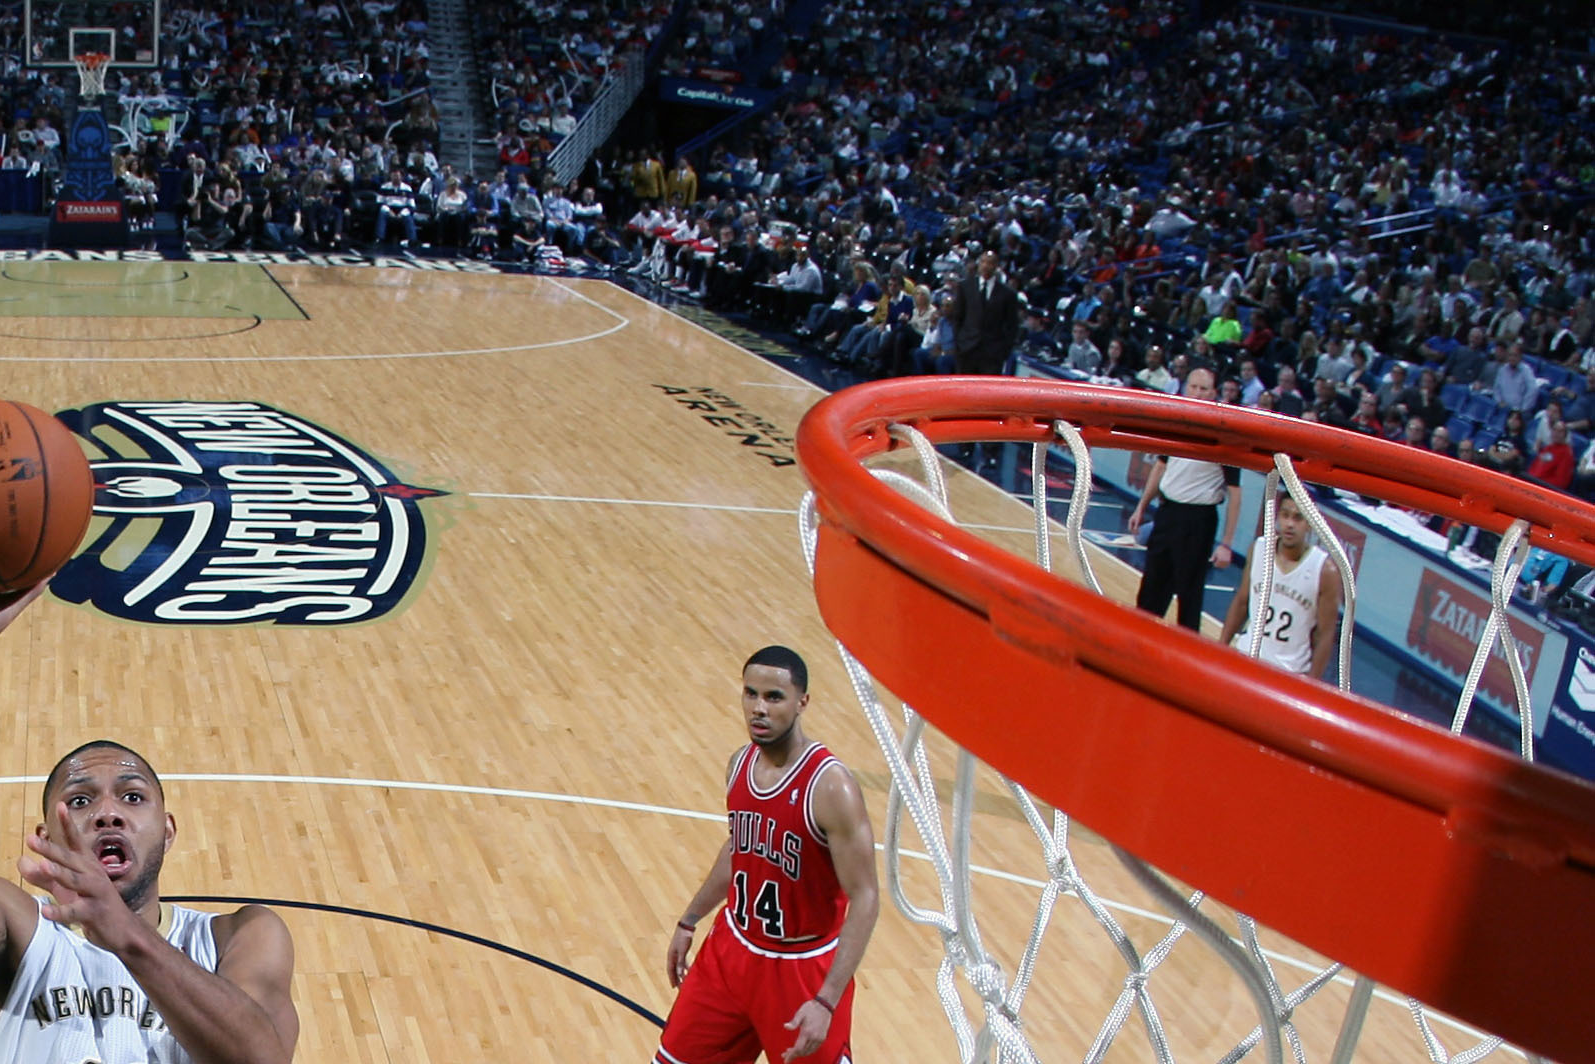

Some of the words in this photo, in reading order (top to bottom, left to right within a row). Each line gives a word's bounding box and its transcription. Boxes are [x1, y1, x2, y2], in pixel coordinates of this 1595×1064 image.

[185, 249, 502, 274] PELICANS
[116, 402, 334, 458] NEW
[650, 383, 796, 468] ARENA
[153, 463, 381, 622] ORLEANS
[1260, 604, 1294, 643] 22
[733, 869, 785, 939] 14
[30, 984, 97, 1033] NEW
